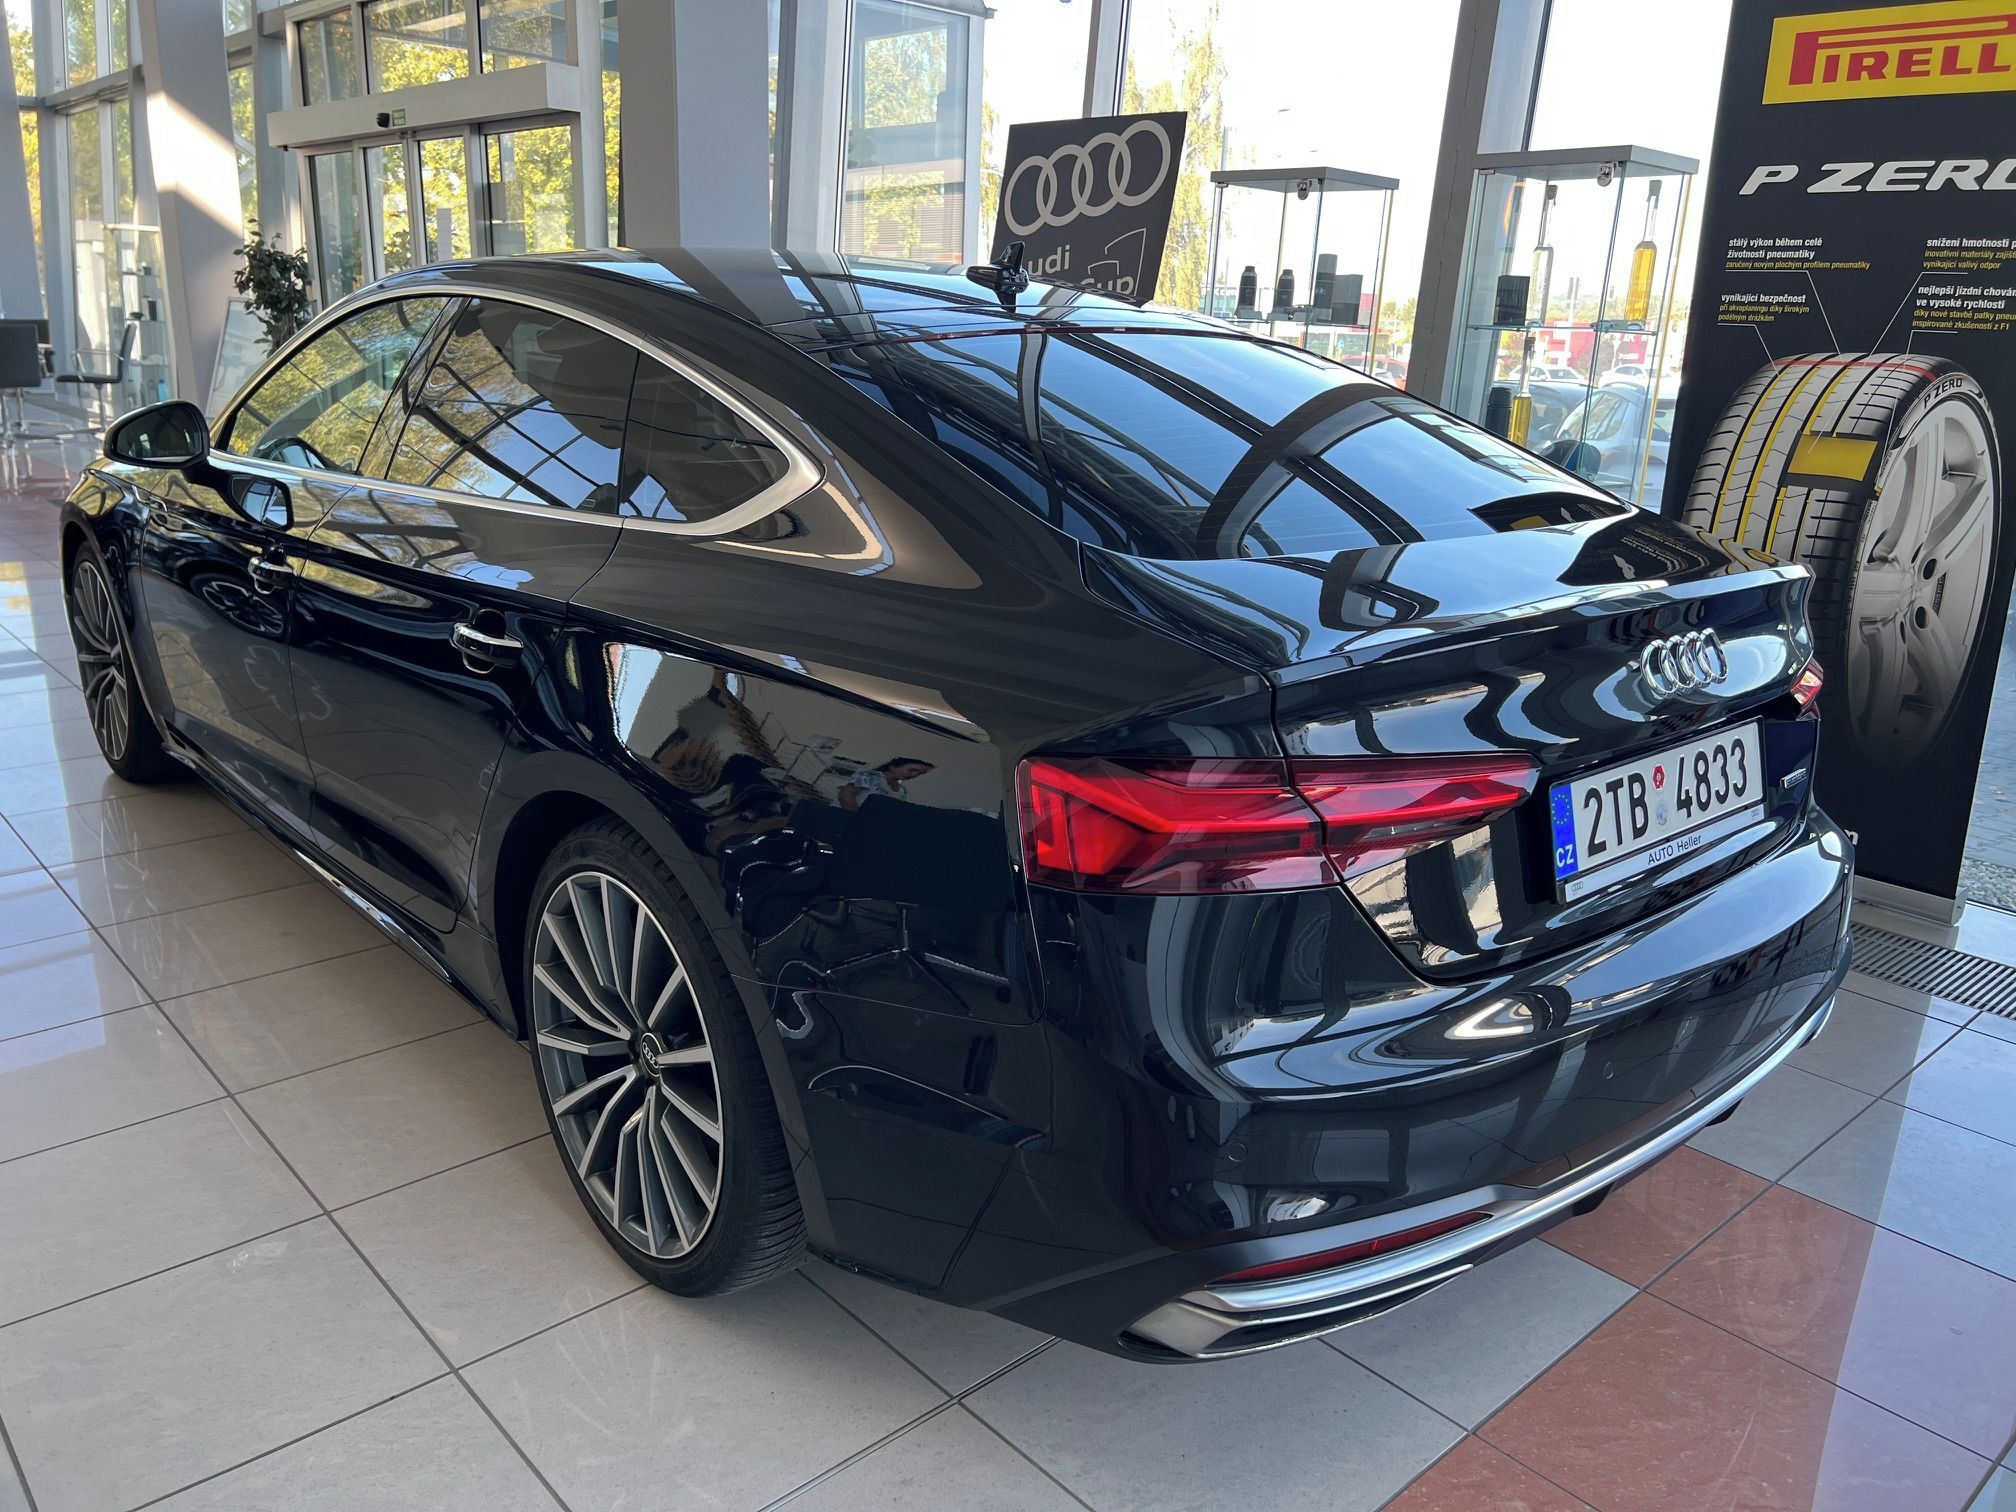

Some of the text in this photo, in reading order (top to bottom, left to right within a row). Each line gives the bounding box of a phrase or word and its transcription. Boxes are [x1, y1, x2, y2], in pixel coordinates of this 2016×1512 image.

[1788, 14, 2016, 86] PIRELL
[1738, 164, 1799, 195] P
[1729, 237, 1823, 247] stálý výkon během celé
[1926, 238, 1961, 247] snížení
[1962, 238, 2009, 248] hmotnosti
[1028, 244, 1071, 276] udi
[1727, 249, 1816, 260] životnosti pneumatiky
[1960, 250, 1994, 259] materiály
[1803, 261, 1830, 269] profilem
[1831, 261, 1871, 271] pneumatiky
[1979, 261, 2002, 271] odpor
[1918, 285, 1955, 296] nejlepší
[1955, 285, 1982, 297] jízdní
[1721, 293, 1806, 304] vynikající bezpečnost
[1728, 304, 1769, 313] akvaplaningu
[1916, 299, 2006, 310] ve vysoké rychlosti
[1930, 310, 1949, 318] nové
[2000, 322, 2010, 331] F1
[1923, 378, 1963, 409] P ZERO
[1583, 736, 1747, 858] 2TB 4833
[1647, 834, 1702, 865] AUTO Heller
[1556, 843, 1575, 868] CZ
